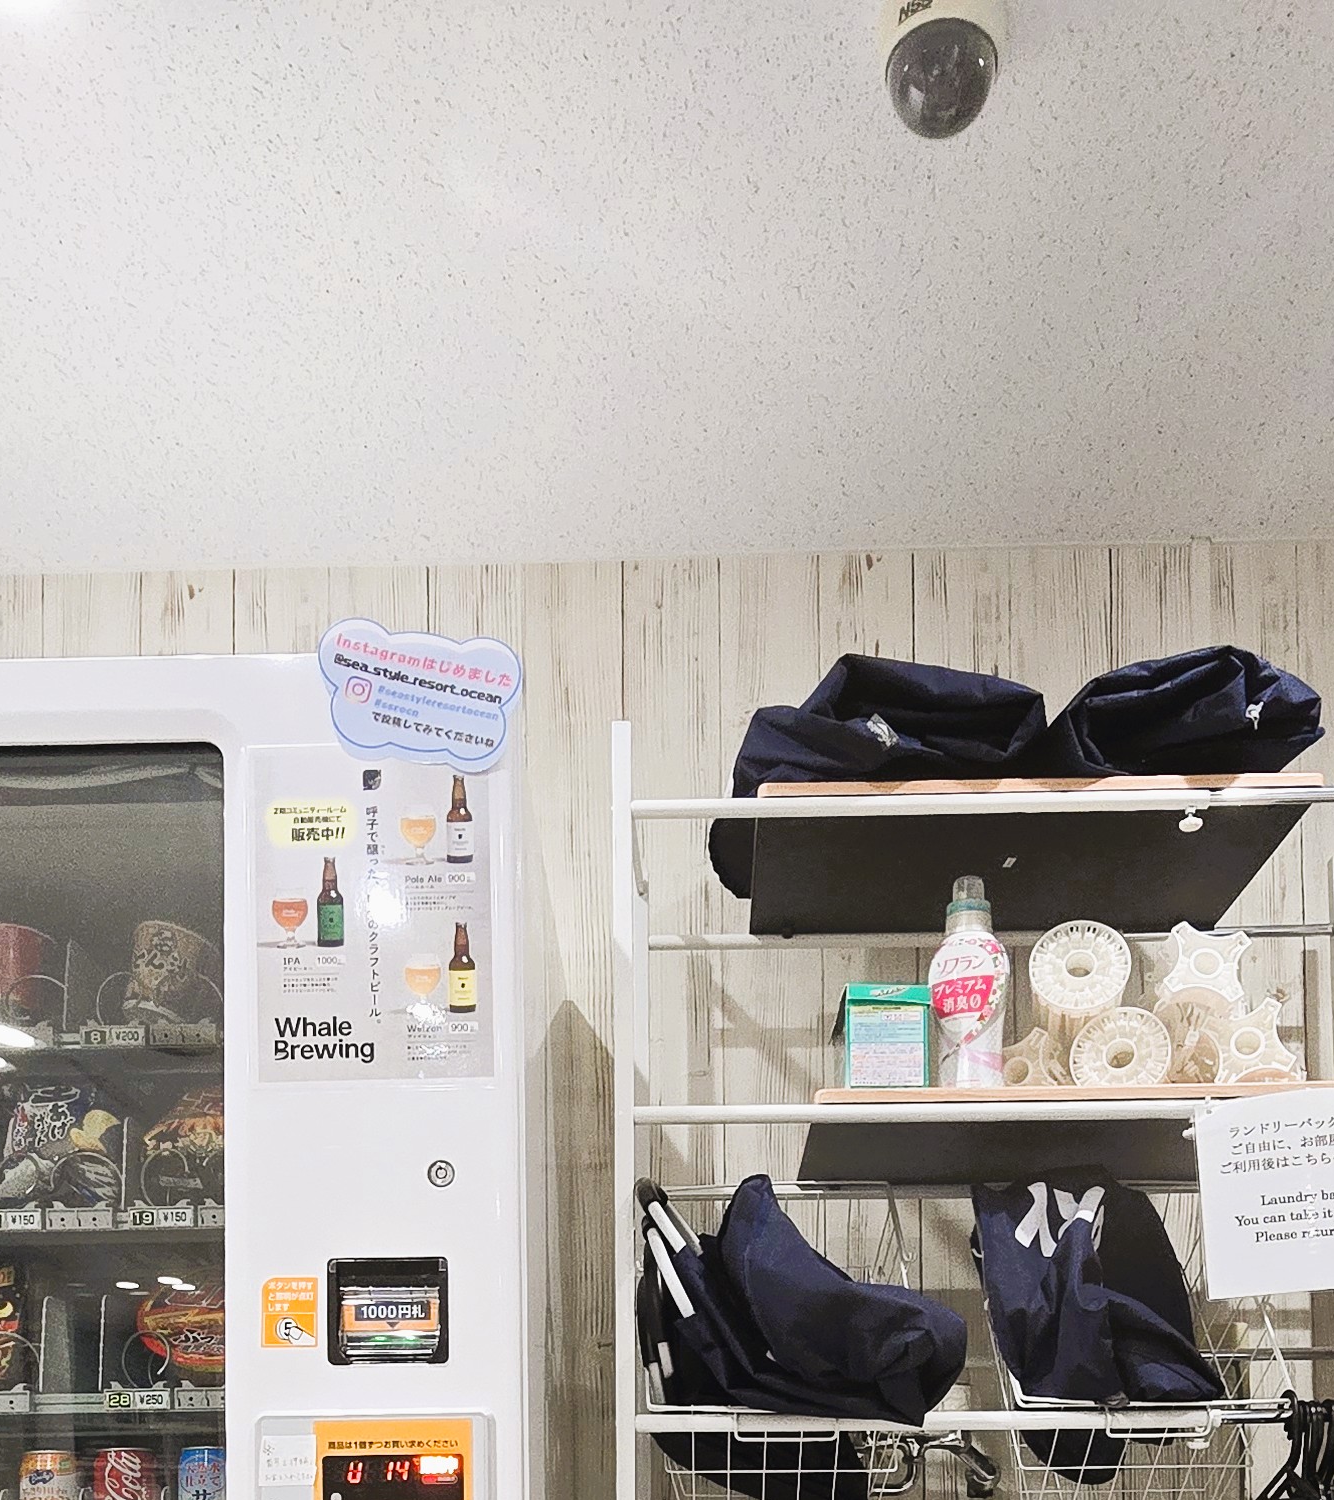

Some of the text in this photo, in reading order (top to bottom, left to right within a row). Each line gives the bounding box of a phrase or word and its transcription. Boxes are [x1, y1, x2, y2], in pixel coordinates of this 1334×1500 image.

[284, 957, 301, 965] IPA
[934, 978, 987, 999] プレミアム
[275, 1016, 353, 1038] Whale
[274, 1039, 375, 1063] Brewing
[1260, 1192, 1318, 1207] Laundry
[11, 1213, 36, 1227] ¥150
[163, 1210, 187, 1224] ¥150
[1235, 1214, 1260, 1228] You
[1263, 1213, 1287, 1224] can
[1322, 1208, 1334, 1219] it
[1255, 1229, 1298, 1243] Please
[360, 1304, 426, 1319] 1000円札
[139, 1394, 164, 1405] ¥250
